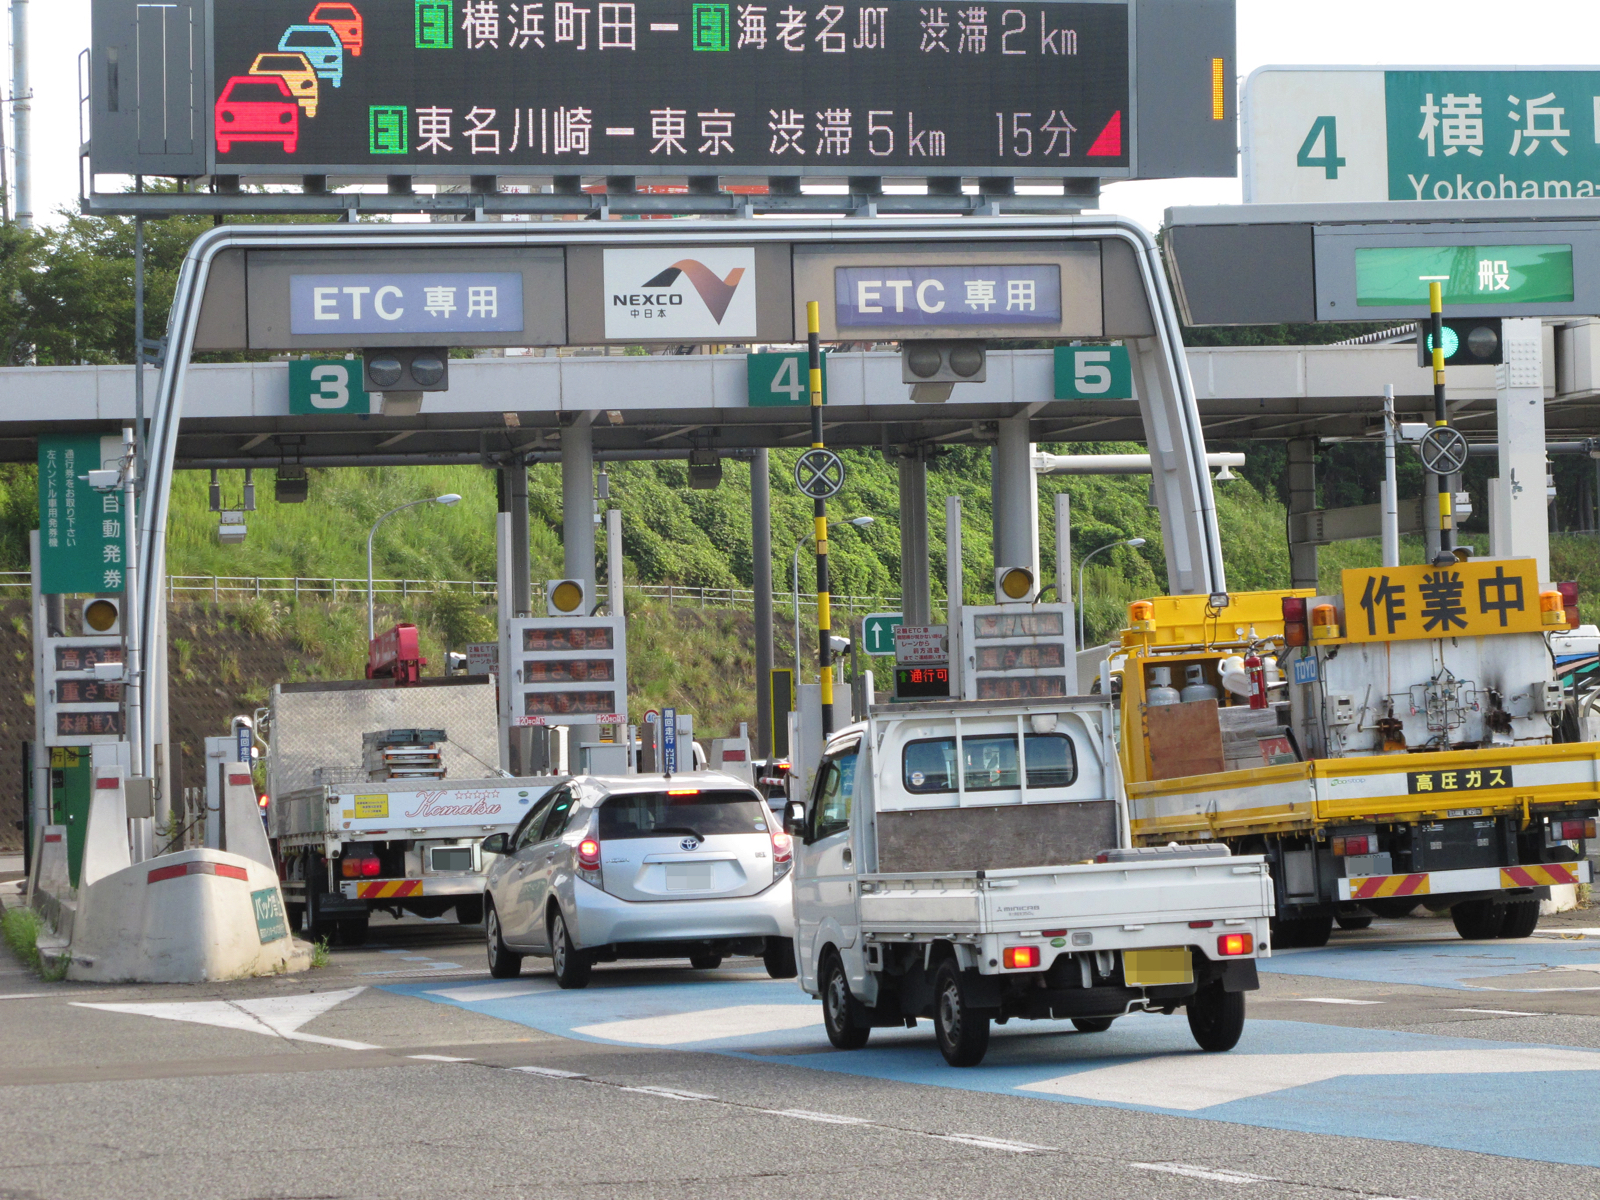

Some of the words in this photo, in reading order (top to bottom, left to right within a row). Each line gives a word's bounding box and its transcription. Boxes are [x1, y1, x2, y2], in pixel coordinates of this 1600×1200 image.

[996, 109, 1078, 156] 15分
[1418, 92, 1600, 158] 横浜
[1296, 115, 1346, 180] 4
[1419, 259, 1511, 291] 一般
[312, 286, 404, 321] ETC
[423, 286, 498, 319] 専用
[613, 294, 683, 306] NEXCO
[857, 279, 946, 314] ETC
[964, 279, 1037, 312] 専用
[630, 308, 667, 318] 中日本
[310, 365, 349, 408] 3
[770, 357, 804, 401] 4
[1074, 351, 1112, 394] 5
[102, 494, 122, 588] 自動発券
[1361, 567, 1526, 636] 作業中
[529, 628, 608, 648] 高さ超過
[61, 650, 127, 669] 高さ超
[530, 661, 609, 681] 重さ超過
[1295, 660, 1316, 680] TOYO
[910, 669, 948, 683] 通行可
[62, 682, 121, 701] 重さ超
[60, 715, 126, 732] 本線進入
[1415, 769, 1506, 792] 高圧ガス
[405, 790, 501, 817] Komatsu
